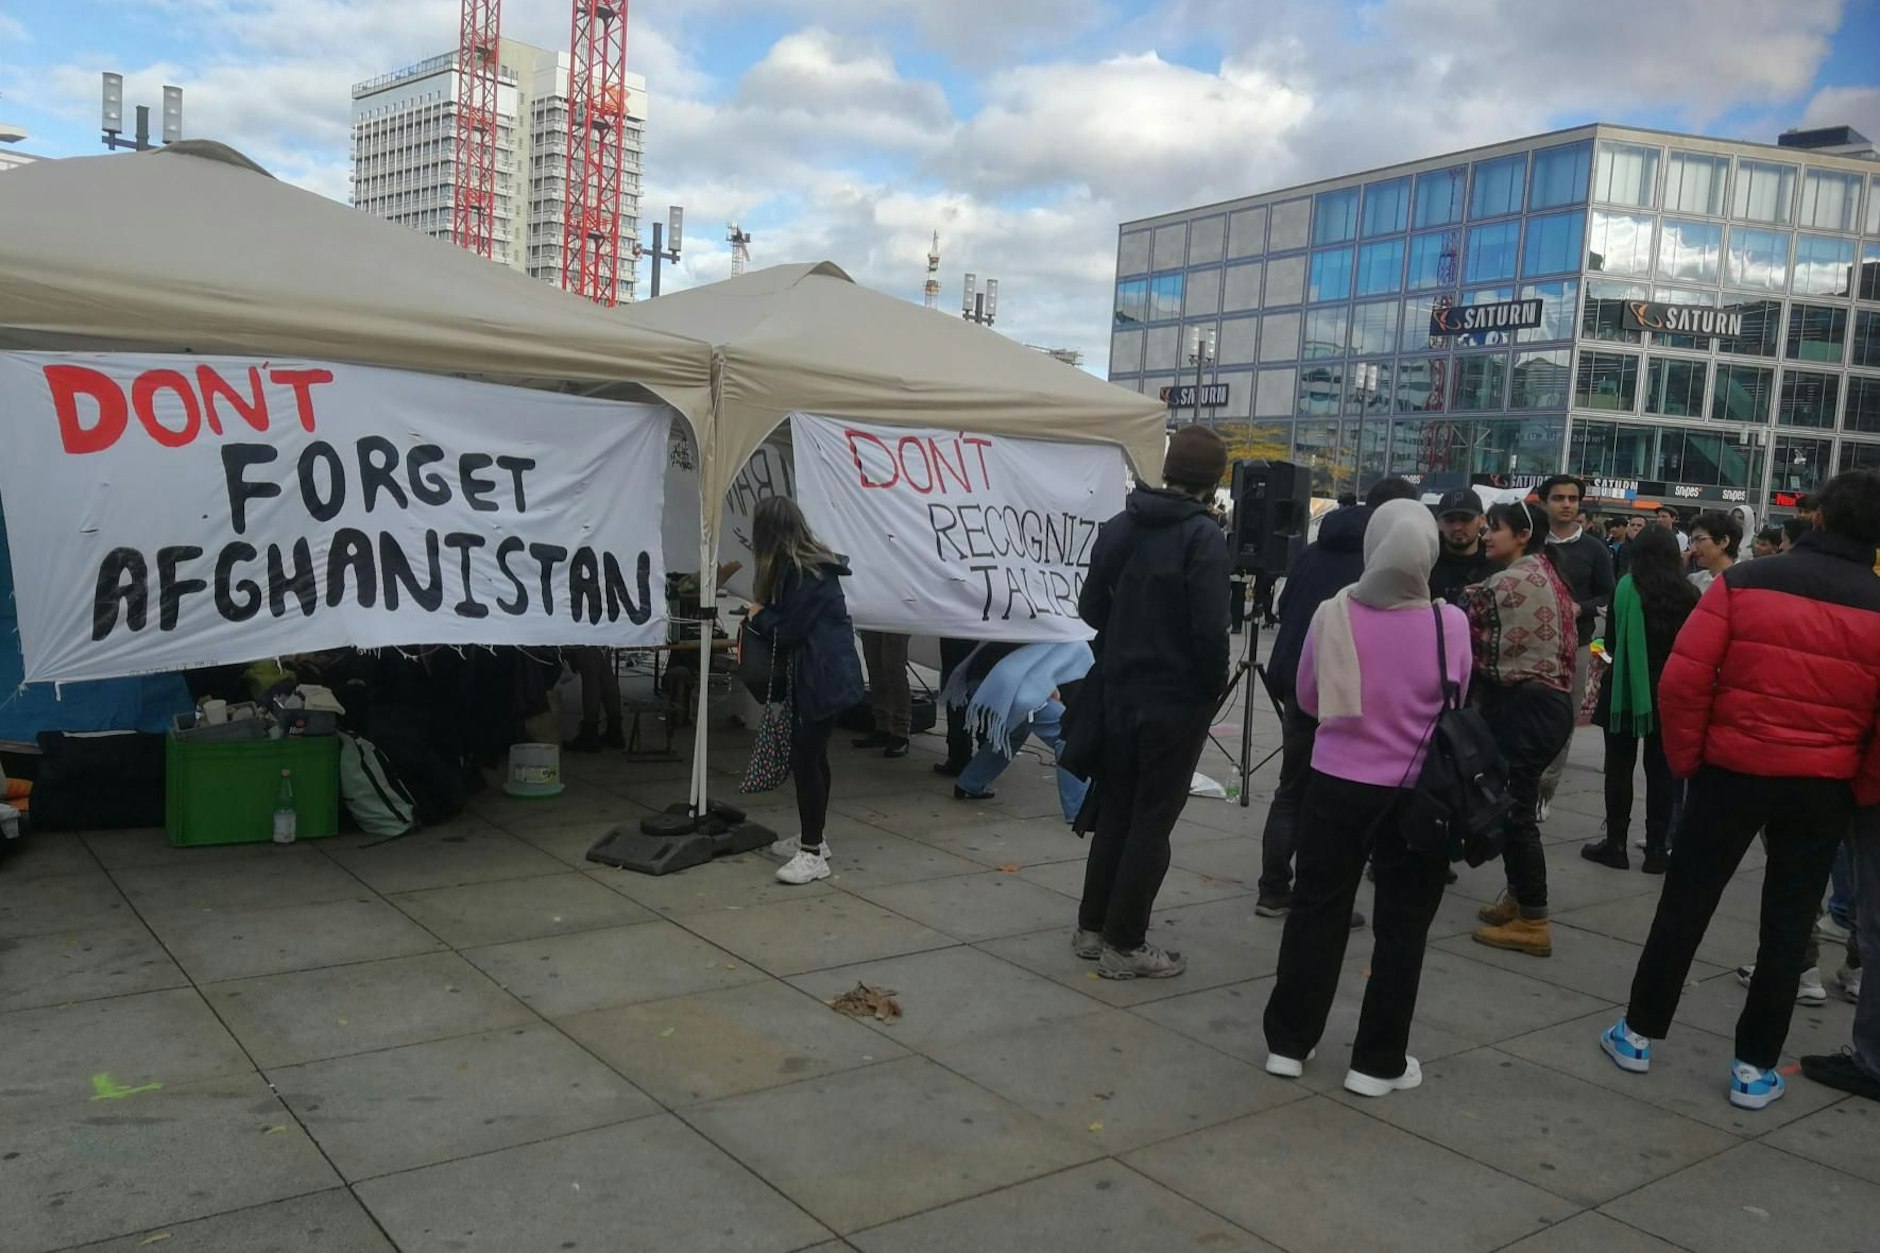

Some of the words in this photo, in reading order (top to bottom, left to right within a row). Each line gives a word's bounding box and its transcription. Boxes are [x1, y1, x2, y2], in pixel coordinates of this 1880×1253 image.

[1464, 302, 1537, 329] SATURN
[1666, 307, 1742, 336] SATURN
[43, 361, 333, 454] DON'T
[1180, 386, 1227, 405] SAURN
[844, 430, 992, 495] DON'T
[221, 435, 536, 534] FORGET
[1511, 474, 1551, 488] SATUR
[1675, 485, 1700, 498] snipes
[1722, 489, 1746, 501] snipes
[927, 503, 1106, 568] RECOGNIZ
[91, 528, 653, 642] AFGHANISTAN
